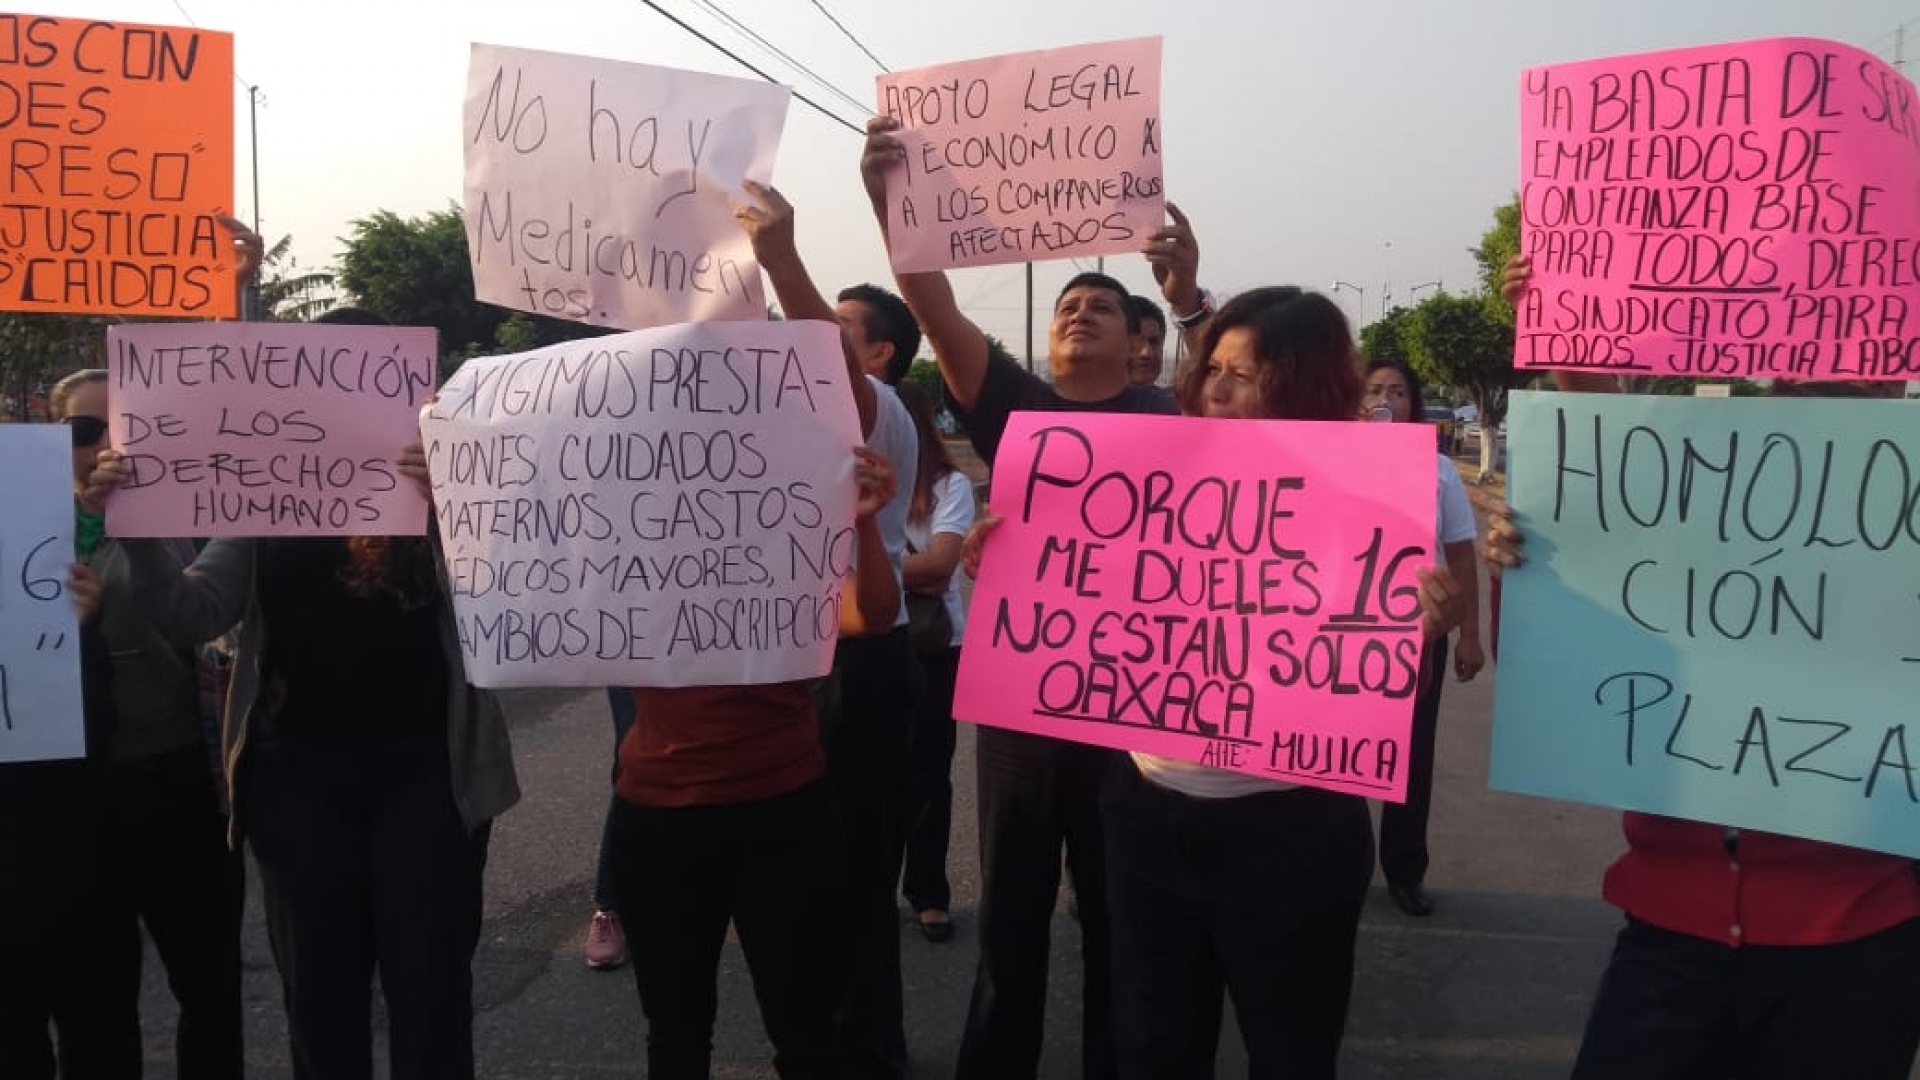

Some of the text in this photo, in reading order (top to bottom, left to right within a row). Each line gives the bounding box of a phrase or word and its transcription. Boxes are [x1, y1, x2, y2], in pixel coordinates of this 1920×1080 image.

[74, 21, 199, 82] CON
[886, 64, 1142, 128] APOYO LEGAL
[1527, 70, 1572, 133] YA
[1590, 57, 1751, 133] BASTA
[1780, 51, 1847, 119] DE
[474, 65, 712, 219] No hay
[1534, 127, 1840, 185] EMPLEADOS DE
[902, 195, 918, 228] A
[938, 185, 989, 222] LOS
[1523, 181, 1885, 236] CONFIANZA BASE
[477, 192, 753, 306] Medicamen
[950, 212, 1134, 262] AFECTADOS
[1528, 229, 1614, 281] PARA
[521, 267, 607, 318] tos.
[1525, 287, 1909, 341] A SINDICATO PARA
[118, 338, 431, 406] INTERVENCIÓN
[648, 346, 832, 416] PRESTA-
[1521, 333, 1636, 366] TODOS
[1669, 338, 1820, 376] JUSTICIA
[121, 407, 326, 445] DE LOS
[119, 453, 396, 491] DERECHOS
[560, 429, 767, 485] CUIDADOS
[194, 488, 381, 528] HUMANOS
[631, 482, 823, 541] GASTOS
[1023, 426, 1305, 559] PORQUE
[447, 544, 570, 599] ÉDICOS
[580, 545, 775, 599] MAYORES,
[1036, 527, 1426, 623] ME DUELES 16
[1622, 548, 1827, 640] CIÓN
[460, 607, 590, 666] AMBIOS
[596, 607, 656, 660] DE
[992, 597, 1418, 699] NO ESTAN SOLOS
[1038, 660, 1255, 738] OAXACA
[1270, 731, 1398, 782] MUJICA
[1595, 671, 1920, 804] PLAZA
